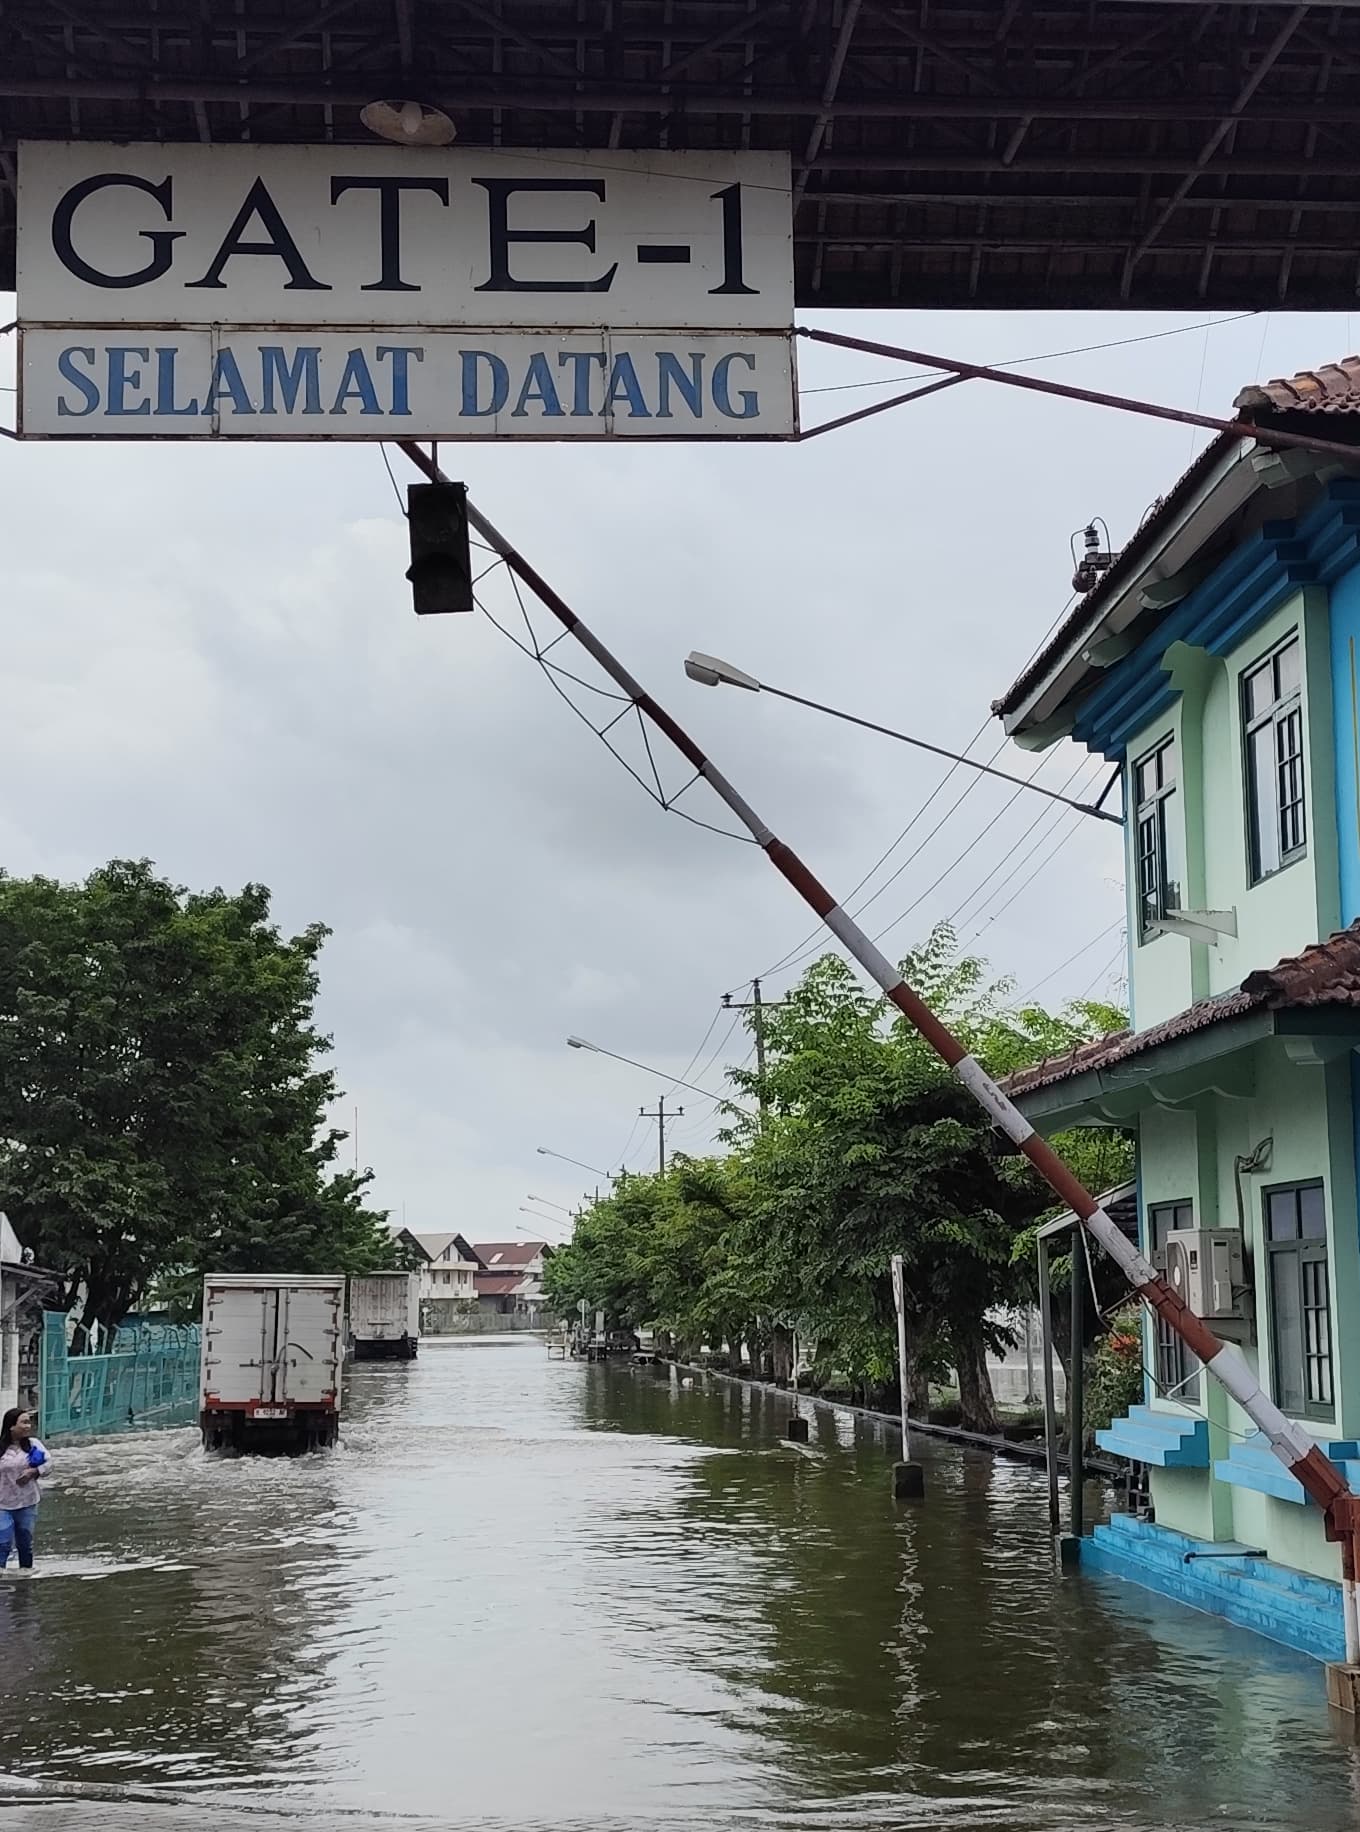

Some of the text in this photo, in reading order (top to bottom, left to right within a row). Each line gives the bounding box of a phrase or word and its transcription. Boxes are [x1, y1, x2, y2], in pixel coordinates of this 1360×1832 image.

[51, 173, 761, 295] GATE-1
[57, 345, 761, 419] SELAMAT DATANG
